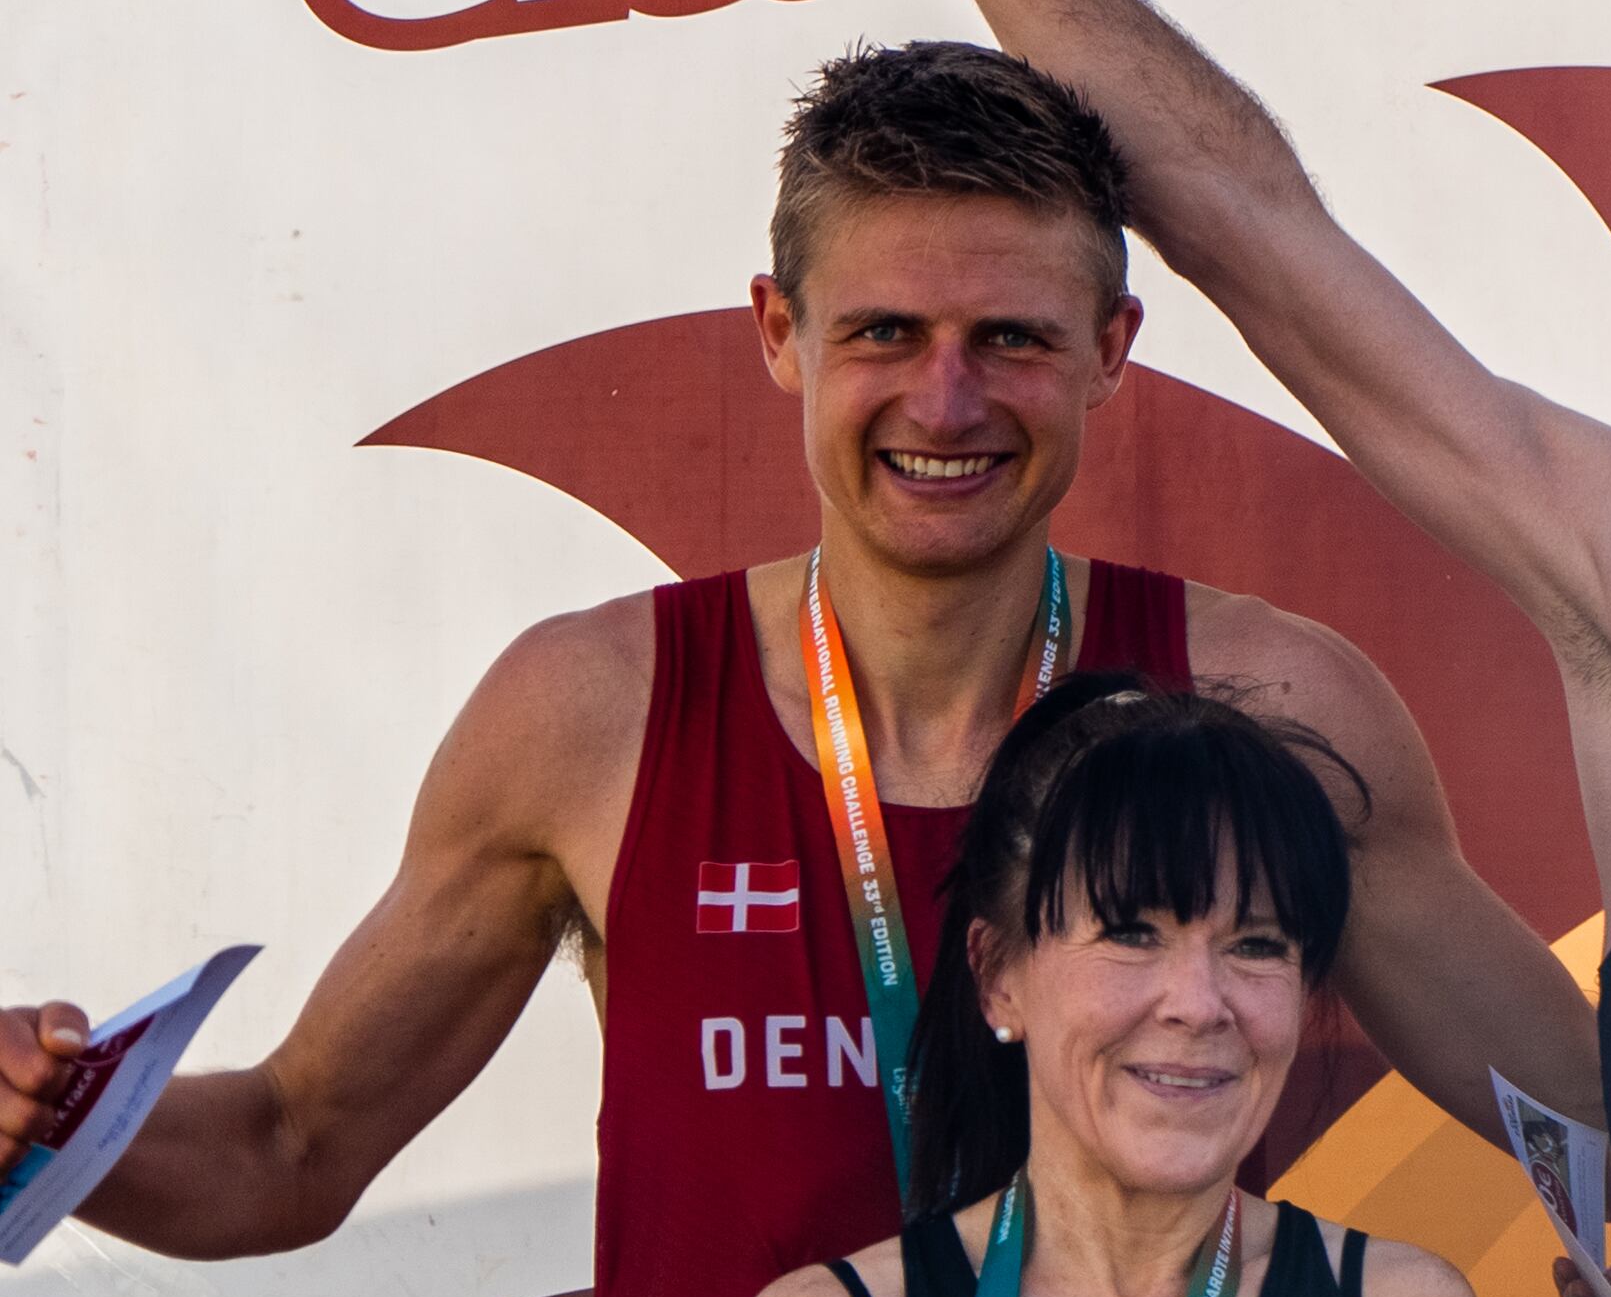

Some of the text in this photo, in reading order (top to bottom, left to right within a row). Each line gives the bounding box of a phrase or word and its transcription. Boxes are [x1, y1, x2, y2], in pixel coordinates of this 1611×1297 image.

[824, 696, 855, 775] RUNNING
[841, 775, 876, 874] CHALLENGE
[870, 916, 898, 987] EDITION
[702, 1015, 878, 1091] DEN
